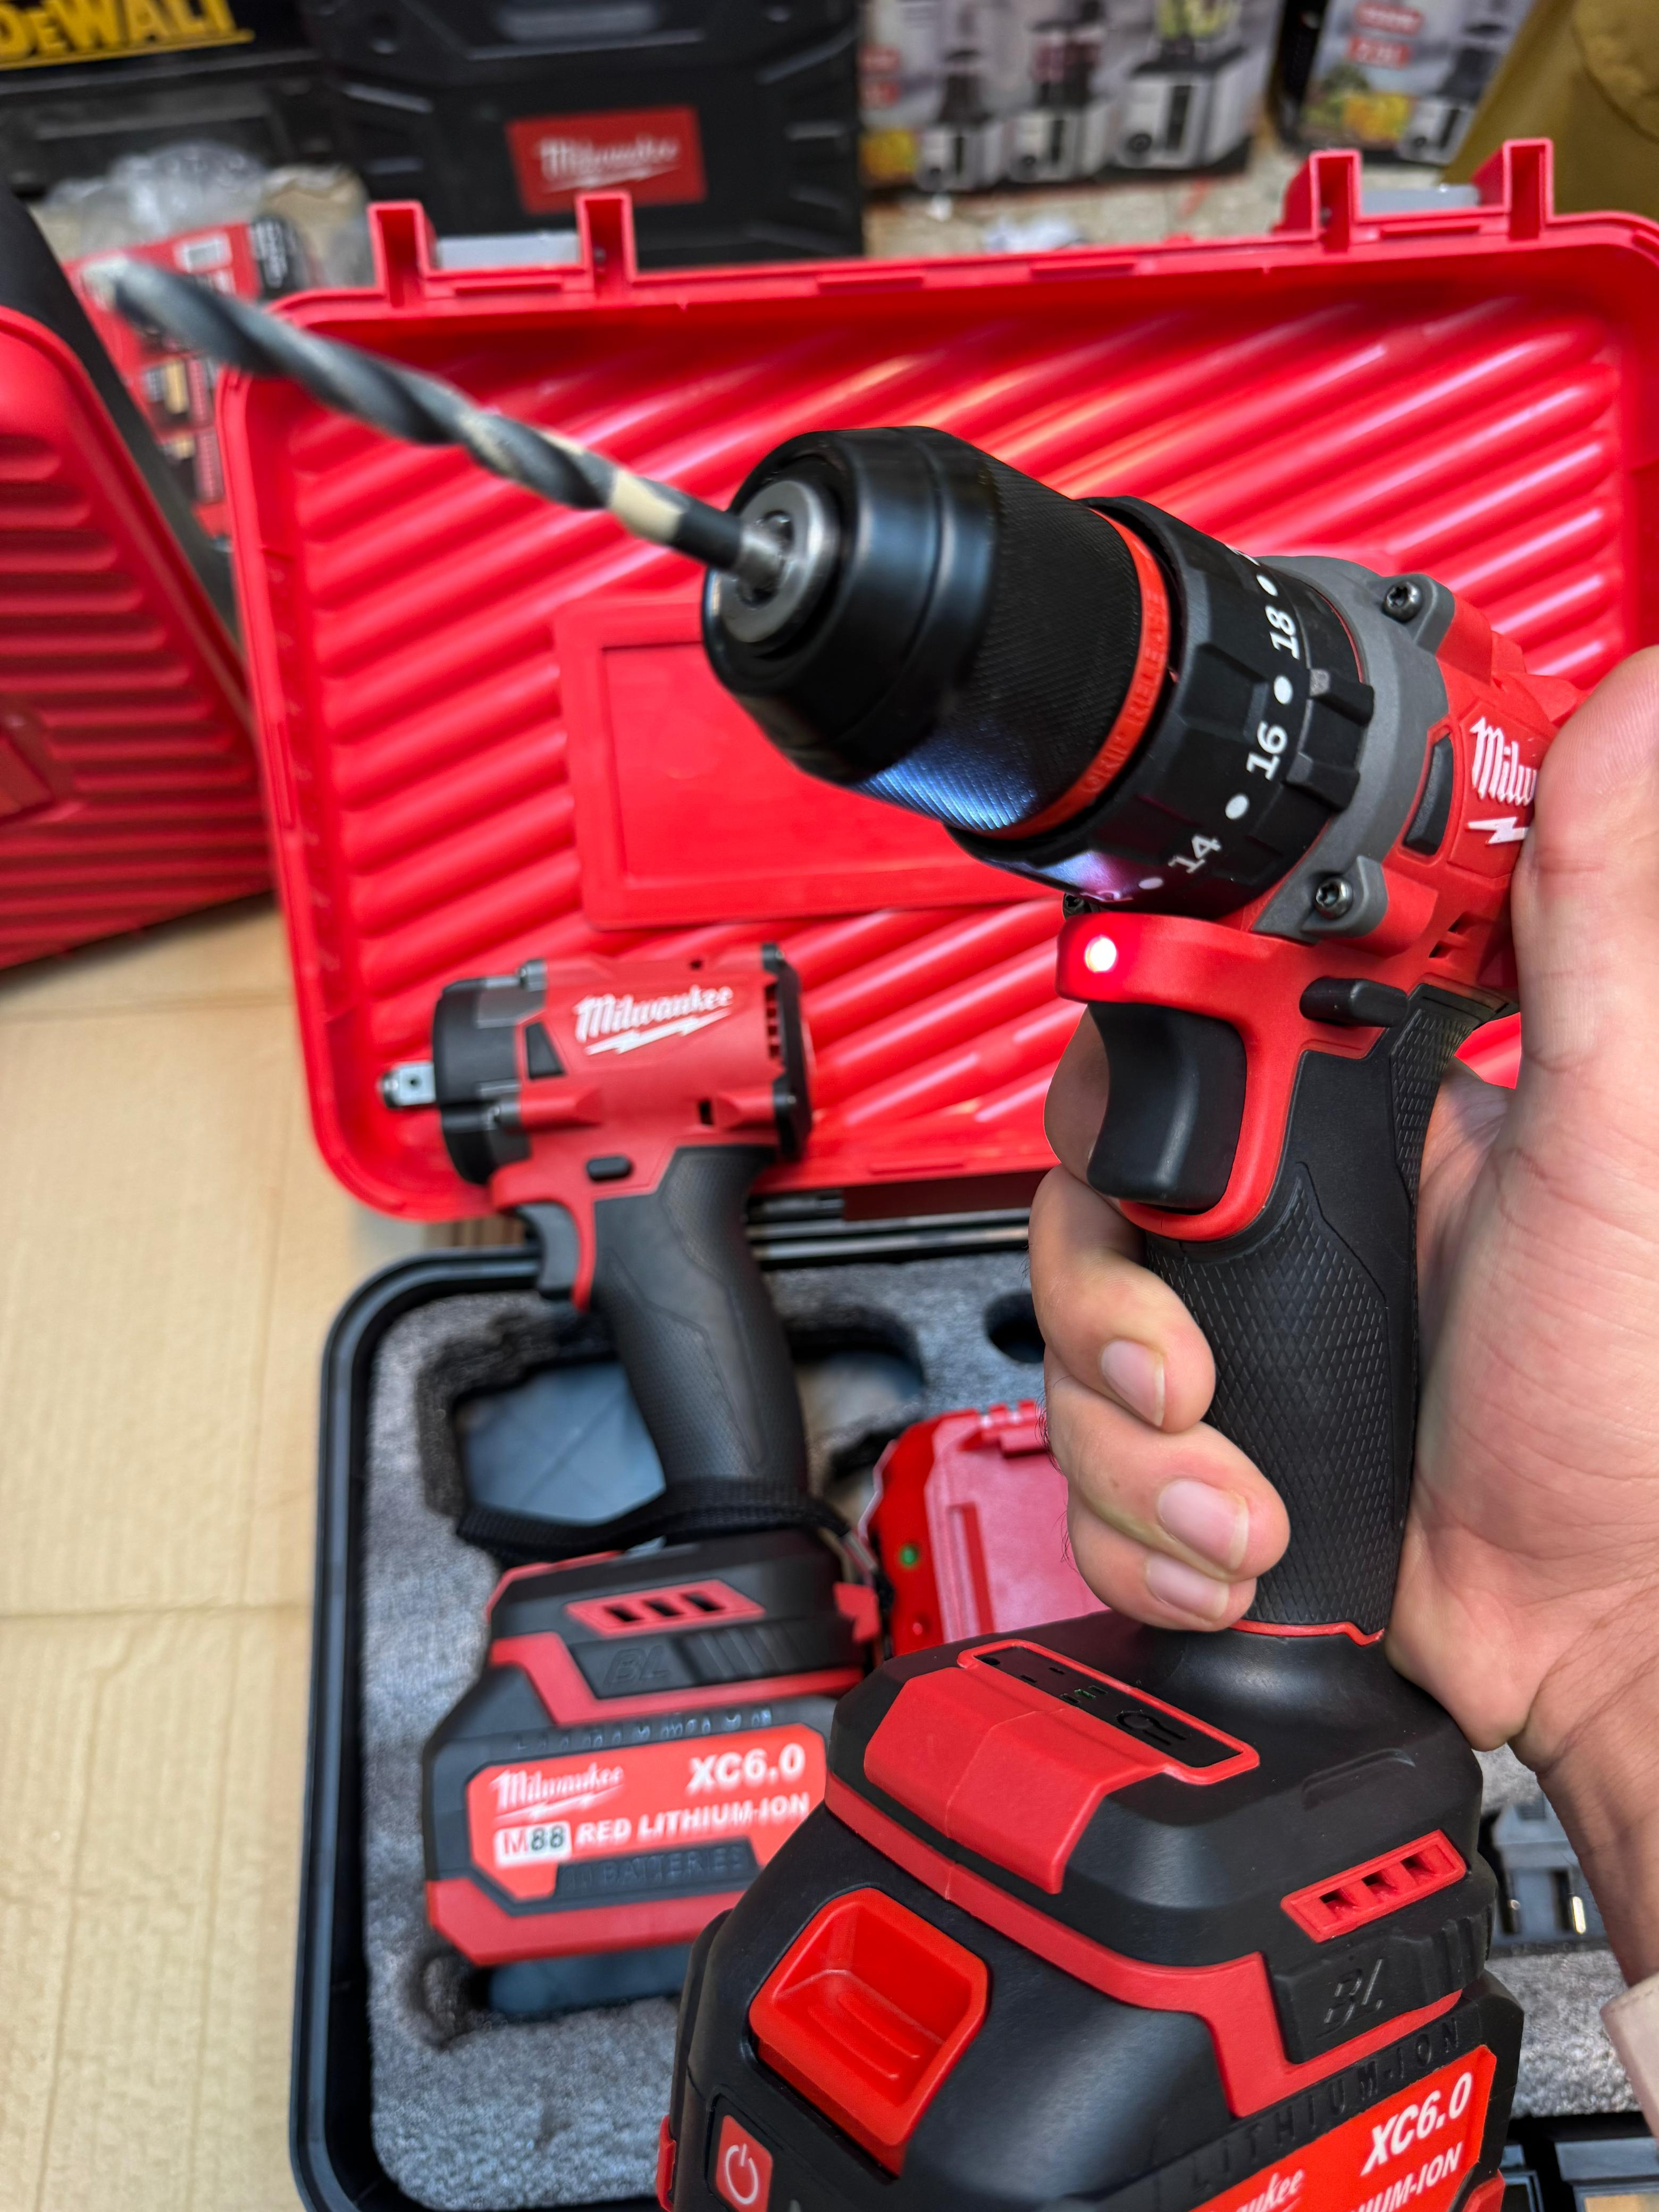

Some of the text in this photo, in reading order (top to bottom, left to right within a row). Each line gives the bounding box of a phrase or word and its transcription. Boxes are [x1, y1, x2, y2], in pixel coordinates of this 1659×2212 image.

[1265, 605, 1300, 660] 18
[1246, 720, 1288, 781] 16
[1168, 835, 1221, 874] 14
[574, 985, 733, 1043] Milwaukee
[489, 1762, 624, 1812] Milwaukee
[686, 1743, 805, 1795] XC6.0
[502, 1792, 810, 1856] M88 RED LITHIUM-ION
[1190, 2017, 1459, 2195] LITHIUM-ION
[1360, 2072, 1472, 2176] XC6.0
